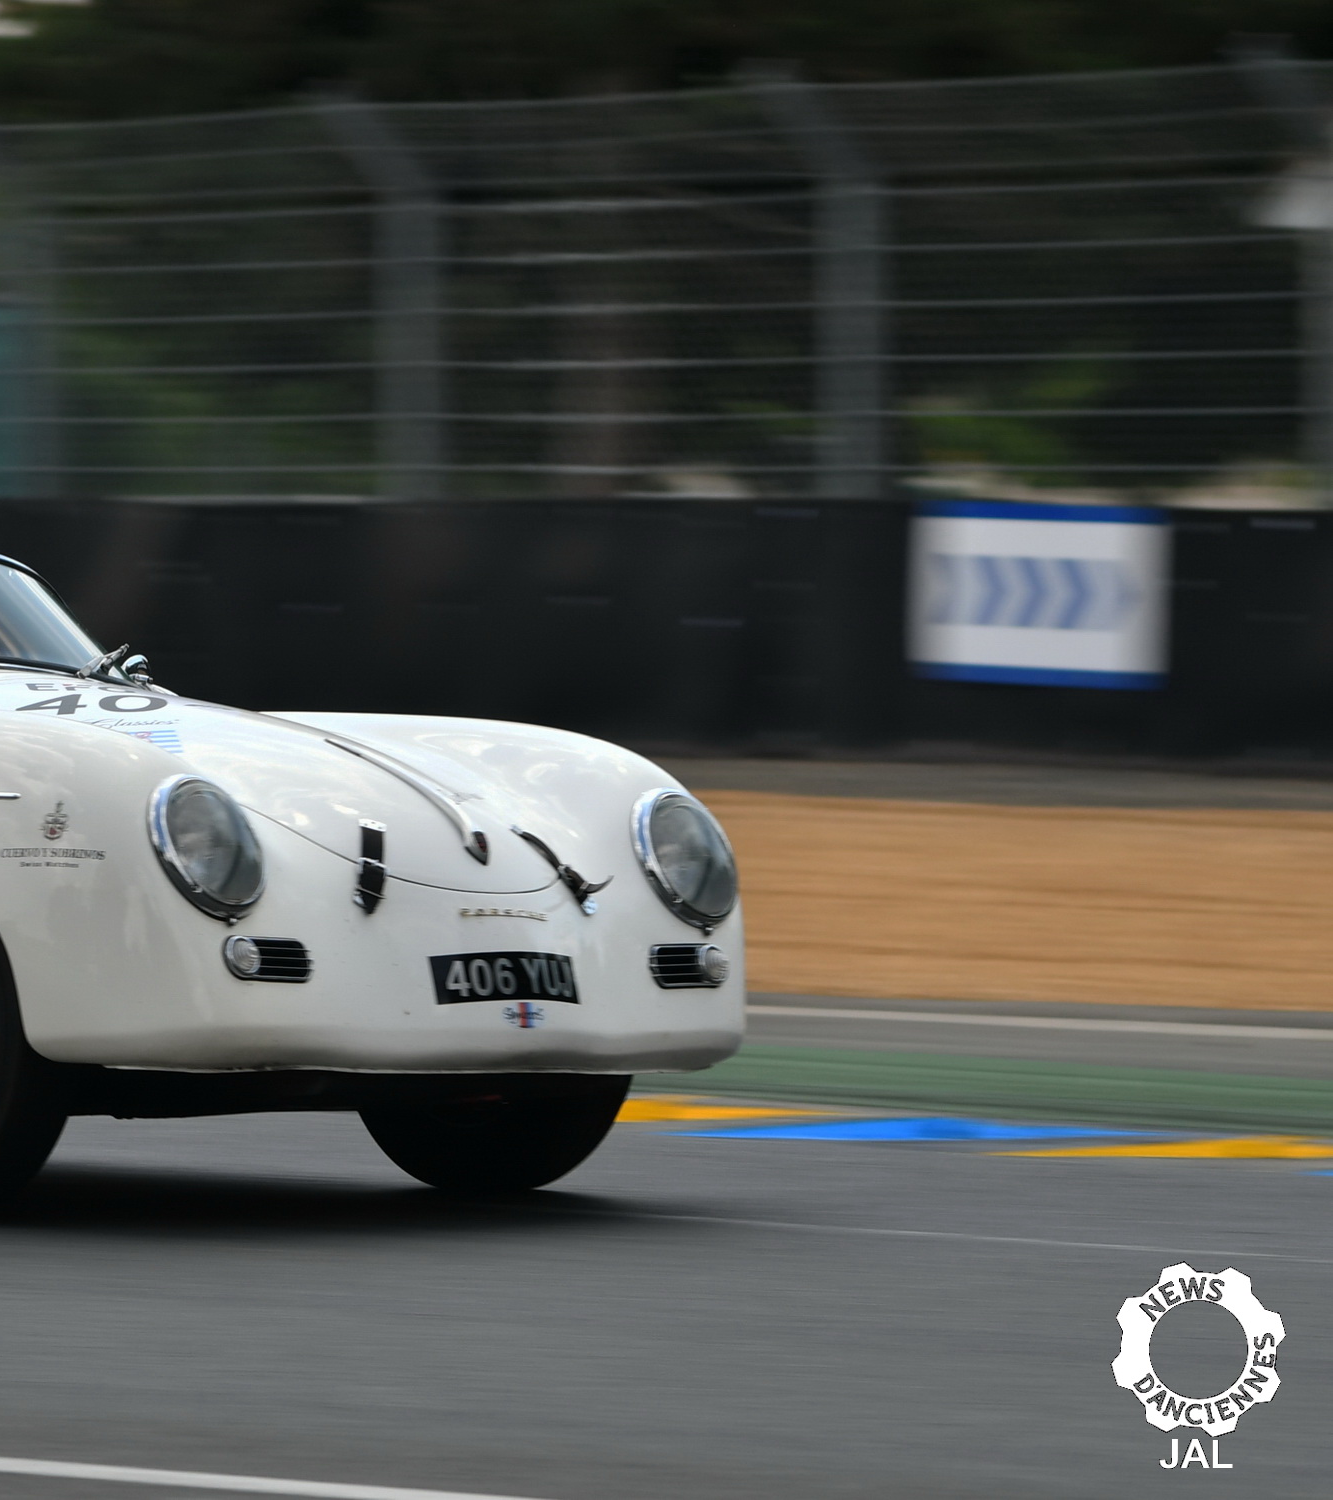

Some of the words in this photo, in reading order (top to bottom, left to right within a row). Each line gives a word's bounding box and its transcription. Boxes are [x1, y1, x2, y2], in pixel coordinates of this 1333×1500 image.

[15, 694, 168, 715] 40
[444, 958, 517, 997] 406
[520, 957, 574, 998] YUJ
